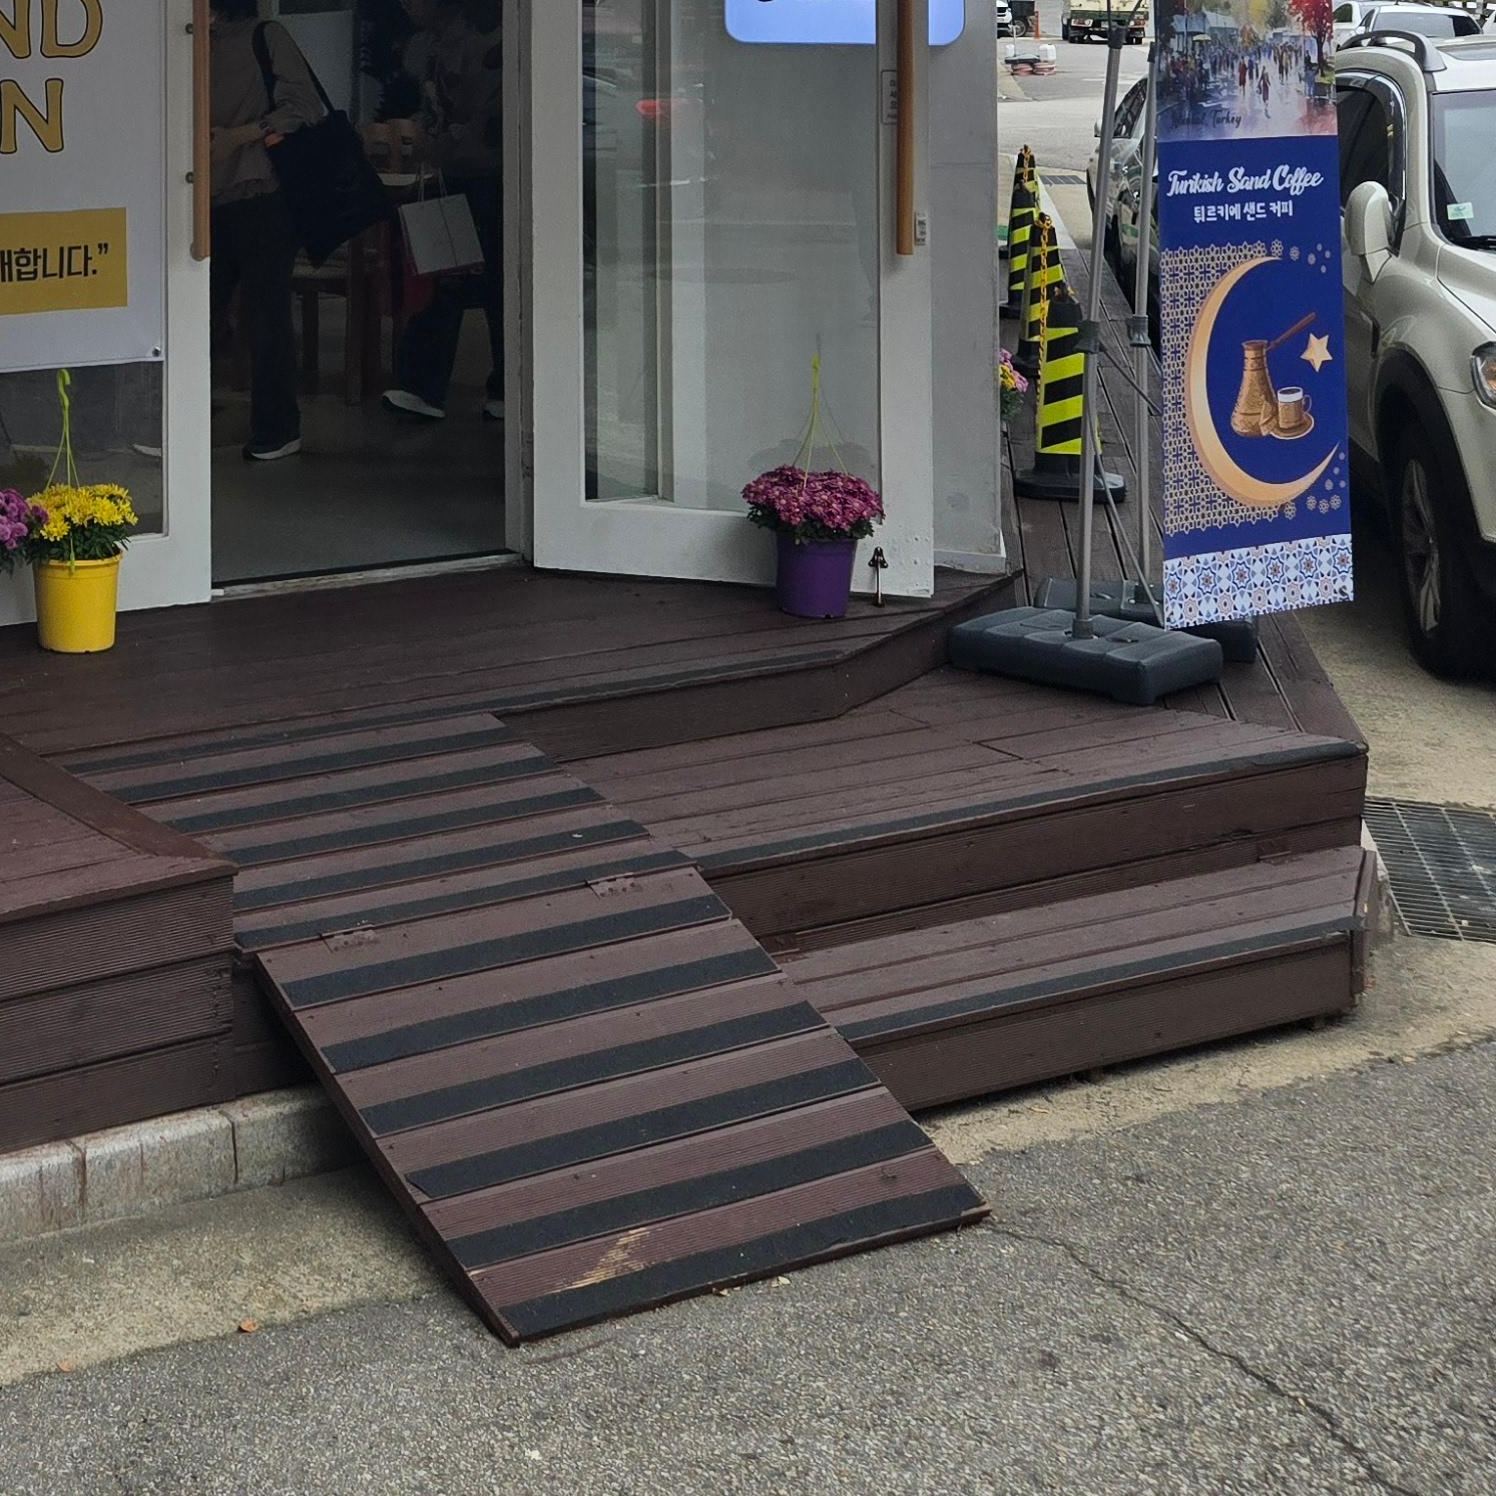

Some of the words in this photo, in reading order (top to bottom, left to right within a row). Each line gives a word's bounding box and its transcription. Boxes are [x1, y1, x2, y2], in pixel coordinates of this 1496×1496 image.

[1227, 166, 1271, 193] Sand
[1272, 164, 1324, 196] Coffee
[1243, 201, 1267, 221] 샌드
[1269, 200, 1293, 217] 커피
